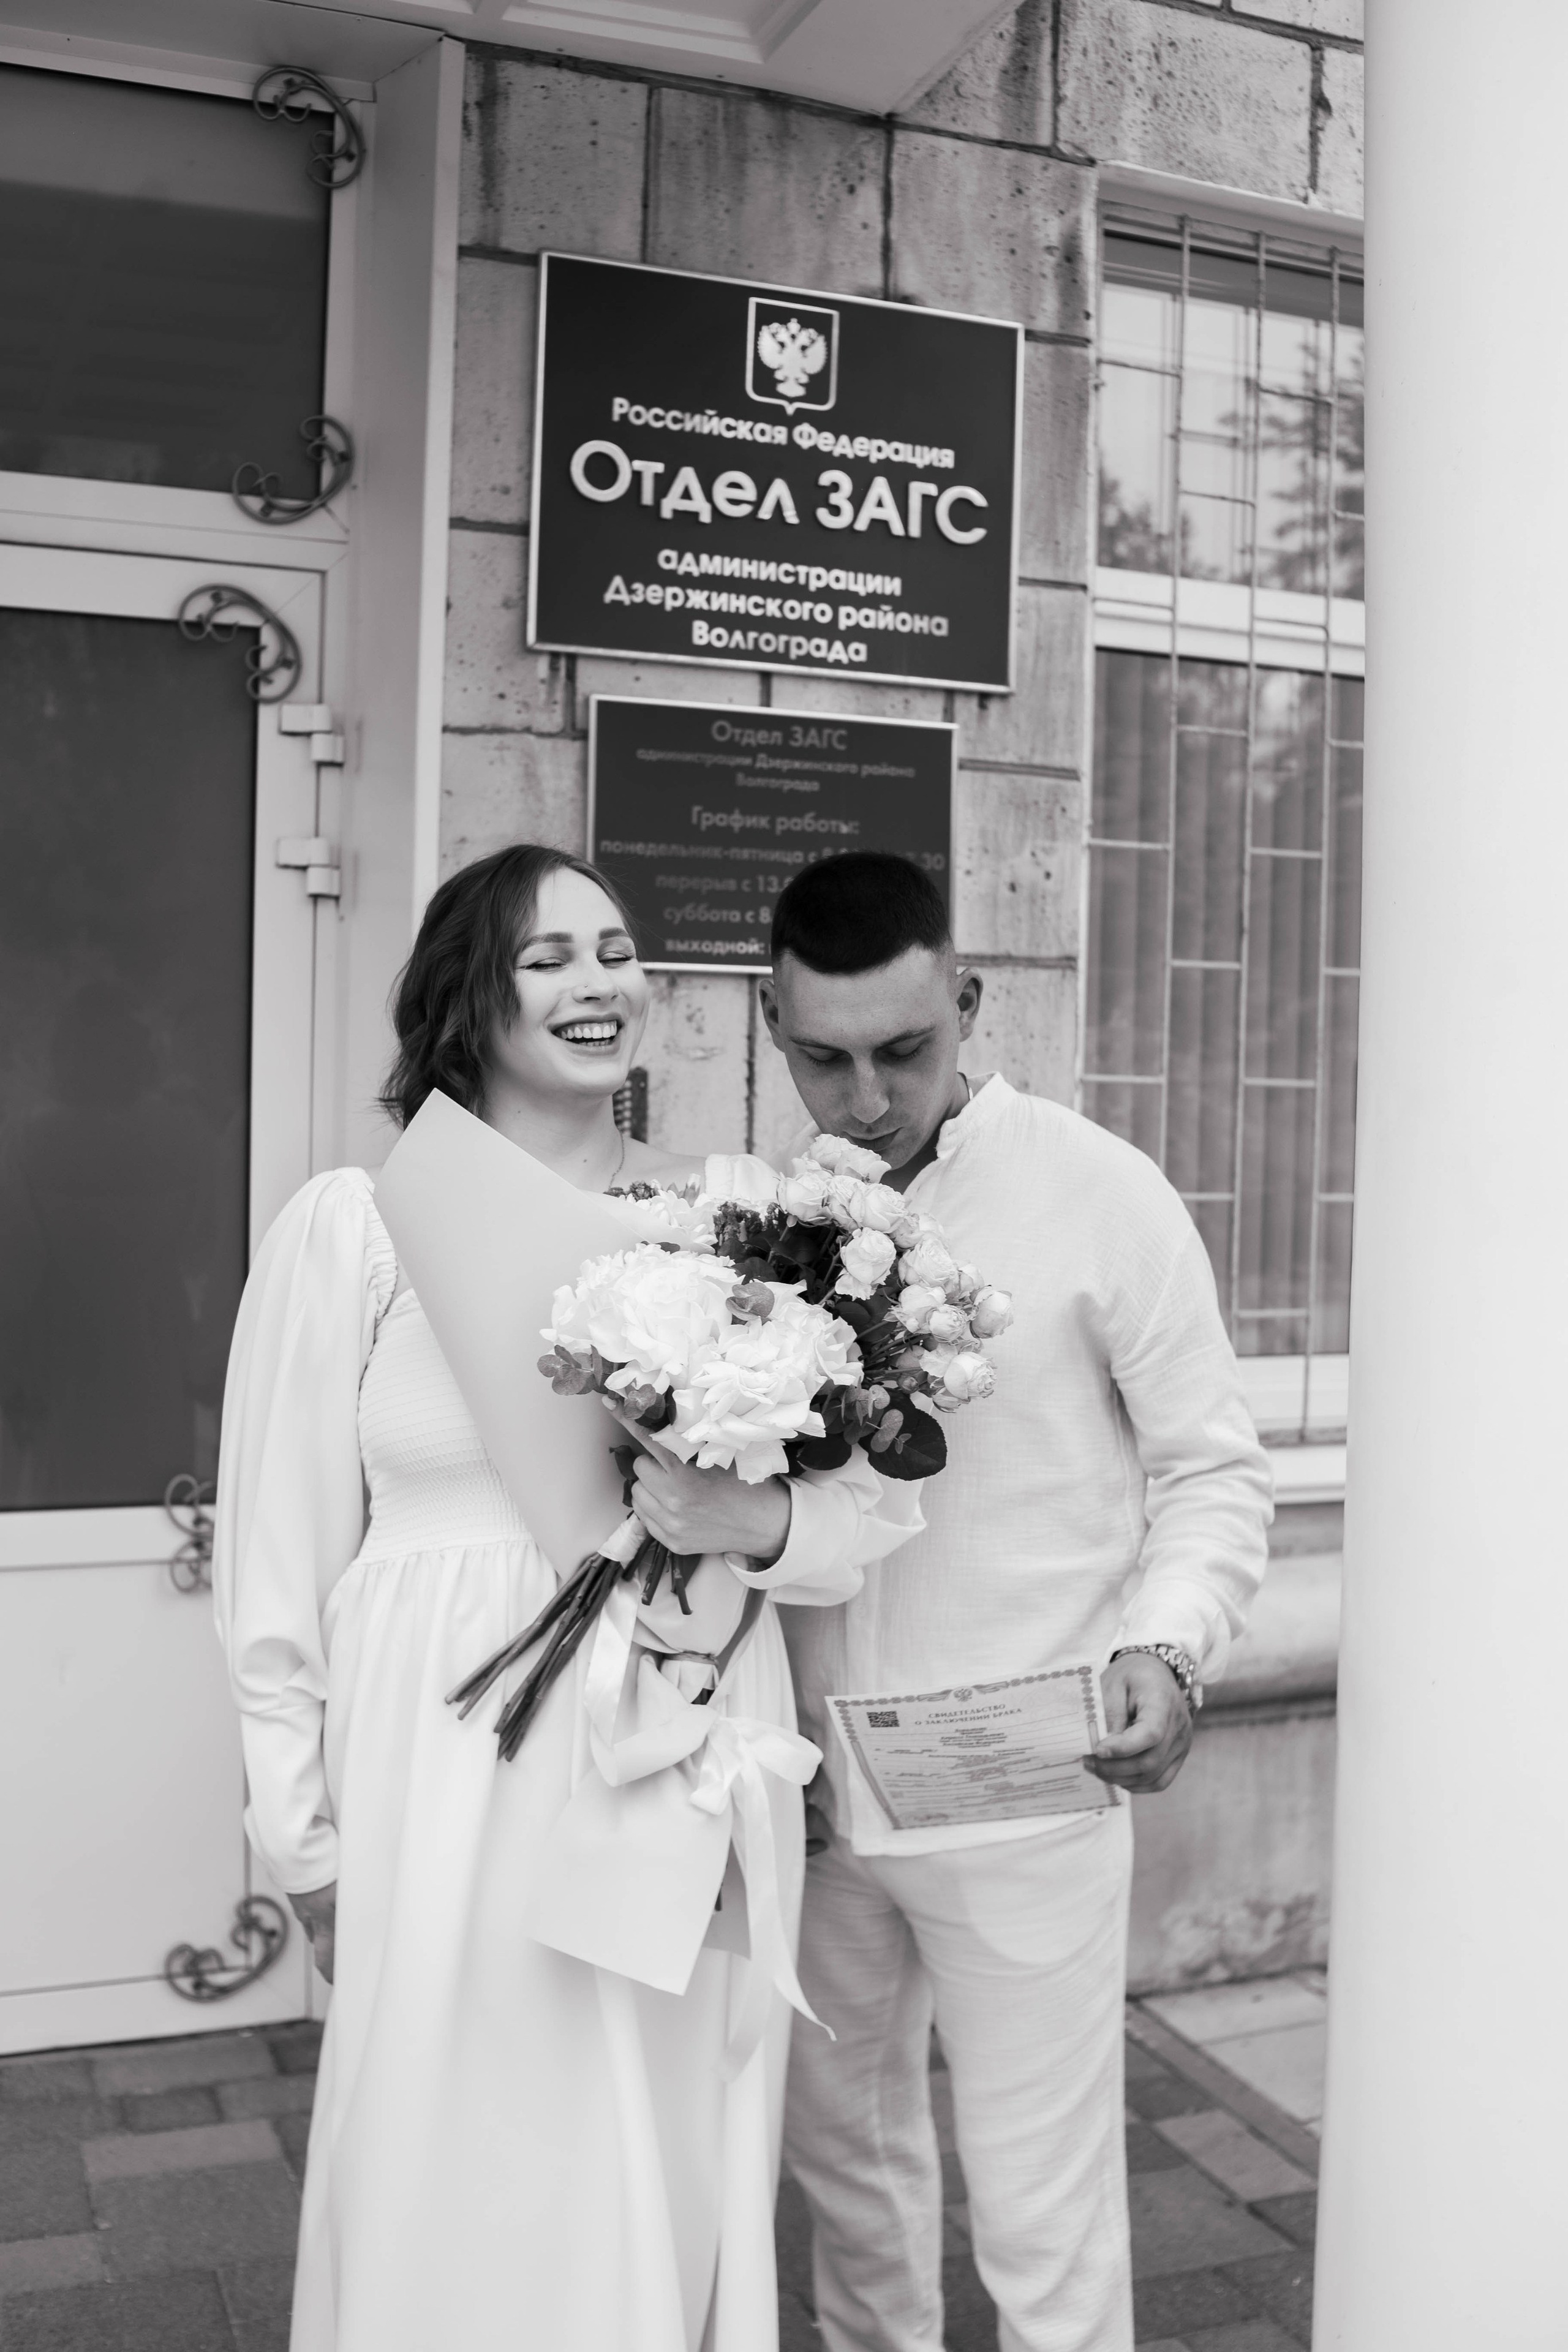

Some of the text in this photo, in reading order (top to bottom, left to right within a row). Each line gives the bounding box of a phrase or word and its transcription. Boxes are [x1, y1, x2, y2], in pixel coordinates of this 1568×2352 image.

[612, 397, 955, 469] Российская Федерация
[570, 439, 989, 545] Отдел ЗАГС
[657, 548, 902, 597] администрации
[603, 575, 949, 637] Дзержинского района
[692, 620, 868, 663] Волгограда
[711, 720, 848, 750] Отдел ЗАГС
[691, 805, 861, 835] График работы:
[600, 840, 804, 865] понедельник-пятница
[741, 878, 751, 892] с
[663, 902, 742, 925] суббота
[745, 910, 755, 924] с
[665, 938, 764, 956] выходной:
[925, 1714, 990, 1725] ЗАКЛЮЧЕНИИ
[993, 1708, 1022, 1718] БРАКА
[929, 1703, 1006, 1718] СВИДЕТЕЛЬСТВО
